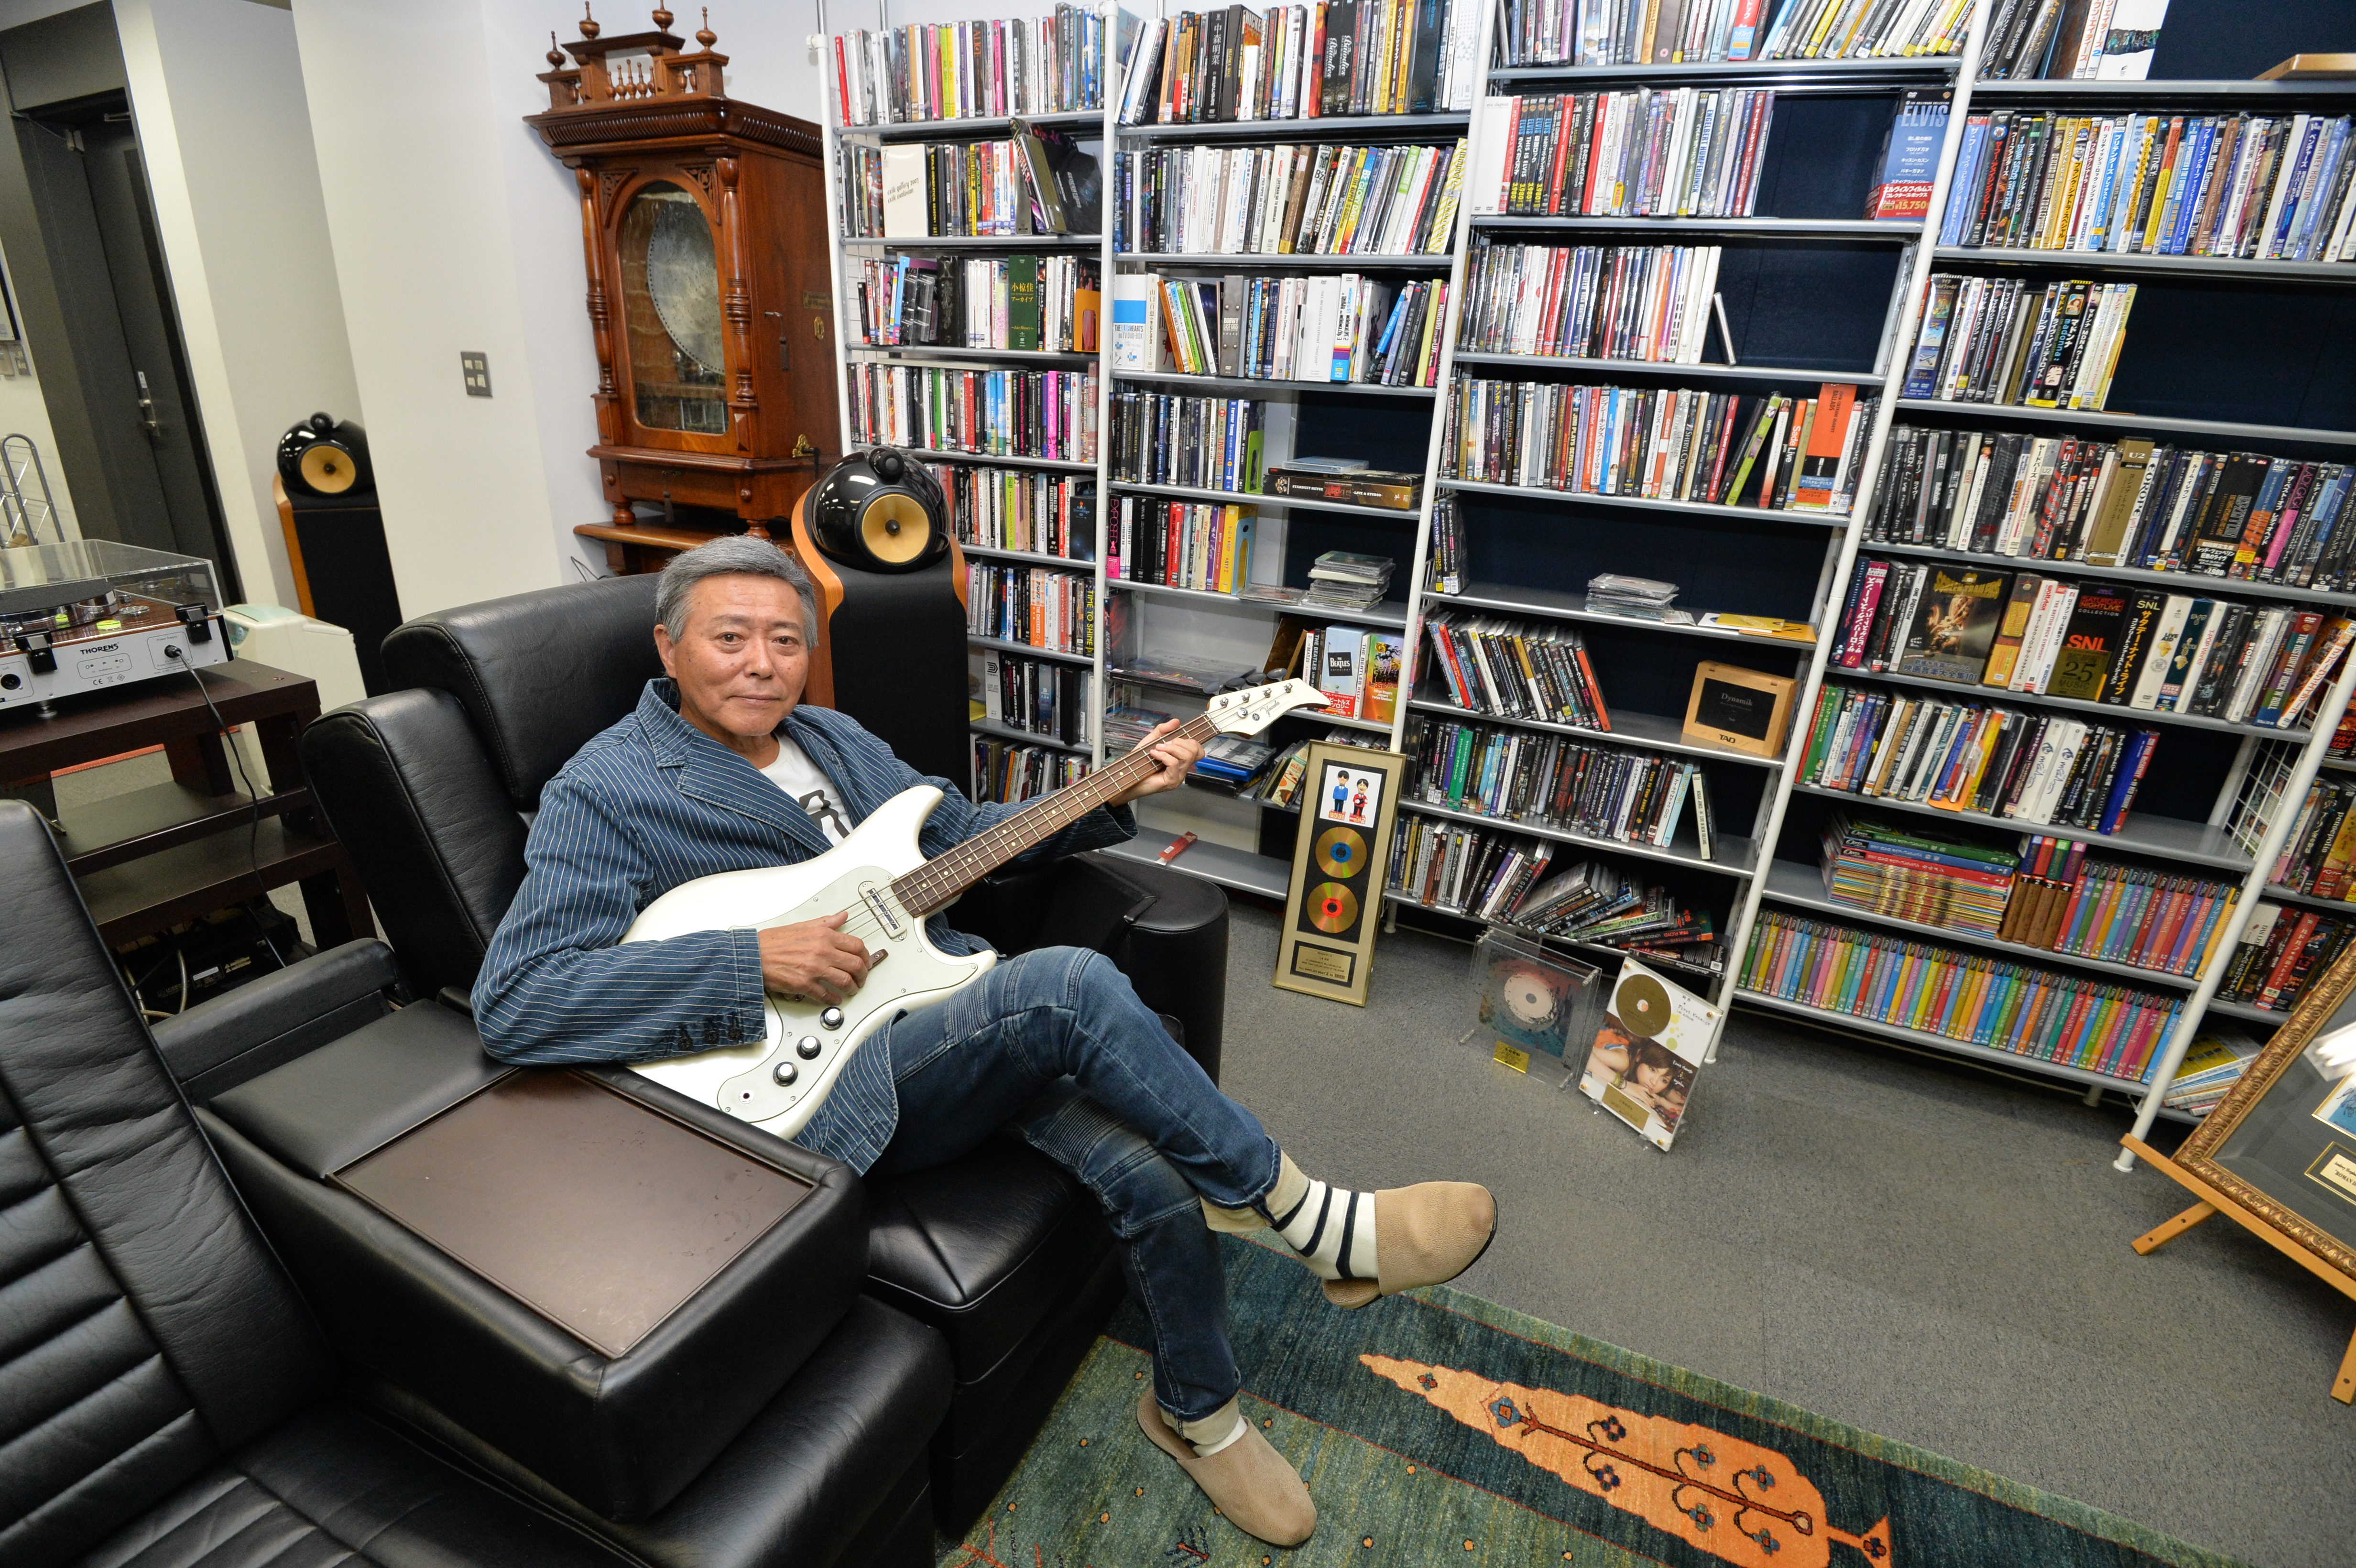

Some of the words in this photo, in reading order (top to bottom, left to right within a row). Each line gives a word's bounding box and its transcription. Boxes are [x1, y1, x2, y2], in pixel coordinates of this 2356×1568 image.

[1211, 23, 1222, 65] 中森明菜
[1900, 104, 1949, 128] ELVIS
[1518, 119, 1527, 135] ELVIS
[1526, 118, 1535, 134] ELVIS
[1534, 118, 1544, 134] ELVIS
[1543, 118, 1552, 134] ELVIS
[1702, 109, 1714, 146] ENGELBERT
[1967, 127, 1981, 152] ザ・フー
[2213, 137, 2223, 153] Blue
[2208, 154, 2218, 170] Man
[2317, 138, 2328, 169] WHITNEY
[1315, 169, 1327, 181] B'z
[1692, 146, 1703, 193] HUMPERDINCK
[910, 177, 919, 187] 2007
[1354, 181, 1365, 200] GLORY
[2302, 171, 2318, 200] HOUSTON
[1348, 202, 1359, 221] DAYS
[1011, 283, 1034, 293] 小椋佳
[2055, 294, 2066, 316] マドンナ
[1435, 304, 1444, 330] MUNEHIRO
[2085, 308, 2095, 327] マドンナ
[2063, 319, 2079, 348] マドンナ
[2077, 330, 2088, 350] MDNA
[1494, 384, 1502, 406] サンタナ
[1829, 390, 1838, 411] BALLADS
[1683, 430, 1692, 451] SHERYL
[1789, 425, 1800, 446] Sade
[1566, 446, 1575, 477] BERKELEY
[1678, 453, 1688, 474] CROW
[1785, 447, 1796, 463] Live
[2030, 443, 2045, 478] ヤードバーズ
[1876, 463, 1887, 489] MARIAH
[2300, 467, 2315, 484] LADY
[2291, 485, 2306, 511] GAGA
[1906, 599, 1917, 621] DIRECTION
[2081, 601, 2101, 610] NIGHT
[2101, 603, 2122, 611] LIVE
[2082, 596, 2123, 605] SATURDAY
[2136, 600, 2161, 610] SNL
[1087, 610, 1094, 621] TO
[1847, 577, 1876, 653] ザ・ローリング・ストーンズ
[2077, 608, 2120, 617] COLLECTION
[1855, 608, 1874, 653] ザ・ビッゲスト・バン
[2298, 633, 2309, 644] THE
[80, 643, 119, 655] THORENS
[2067, 634, 2109, 652] SNL
[1330, 657, 1351, 668] BEATLES
[2115, 610, 2152, 696] サタデー・ナイト・ライブ
[2286, 644, 2304, 667] HISTORY
[1903, 664, 1978, 682] 映画音楽大全集101
[2062, 661, 2097, 682] 25
[2283, 667, 2294, 675] OF
[2276, 675, 2290, 690] ROCK
[1721, 693, 1753, 707] Dynamik
[2267, 696, 2281, 709] ROLL
[1719, 734, 1736, 744] TAD
[1523, 869, 1533, 881] BEE
[1513, 881, 1526, 897] GEES
[2072, 880, 2085, 899] カルメン
[2112, 886, 2123, 906] アイーダ
